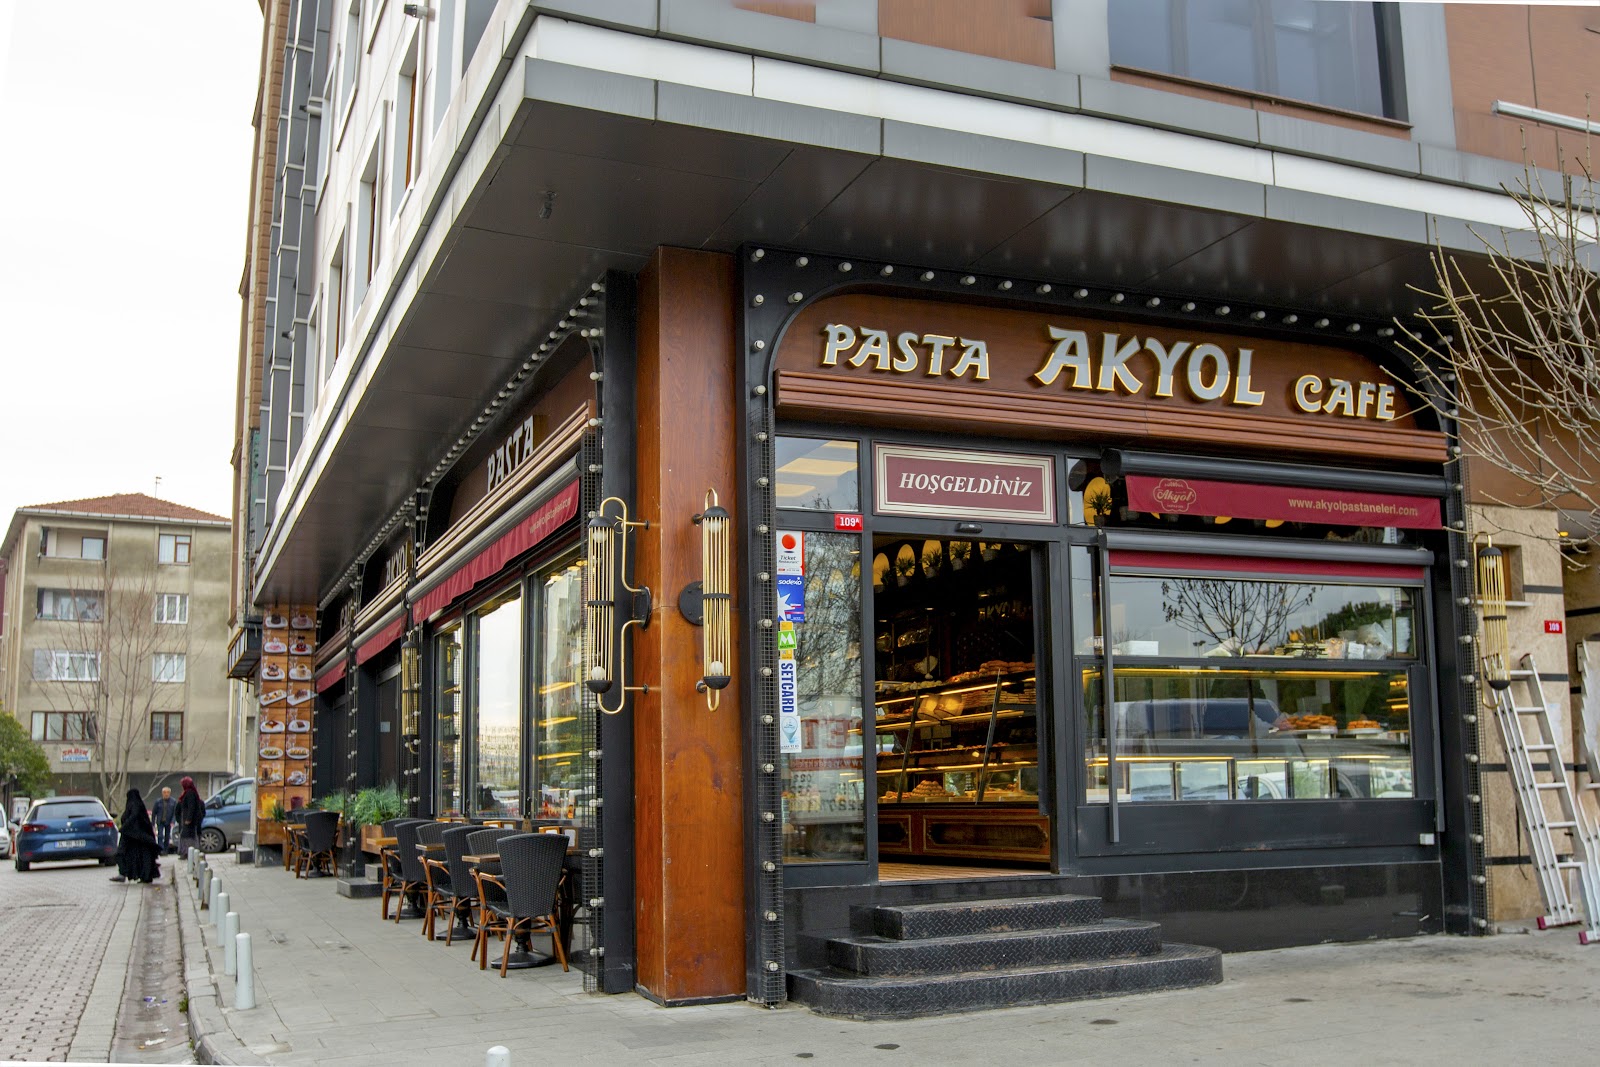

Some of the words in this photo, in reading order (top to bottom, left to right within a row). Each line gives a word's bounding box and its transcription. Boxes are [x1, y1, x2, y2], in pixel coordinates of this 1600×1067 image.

[823, 323, 990, 380] PASTA
[1034, 324, 1266, 406] AKYOL
[1295, 374, 1396, 420] CAFE
[487, 414, 534, 494] PASTA
[898, 472, 1033, 497] HOŞGELDİNİZ
[1156, 488, 1192, 503] Akyol
[1288, 498, 1419, 517] www.akyolpastaneleri.com
[778, 577, 802, 585] sodexo
[781, 663, 795, 713] SETCARD
